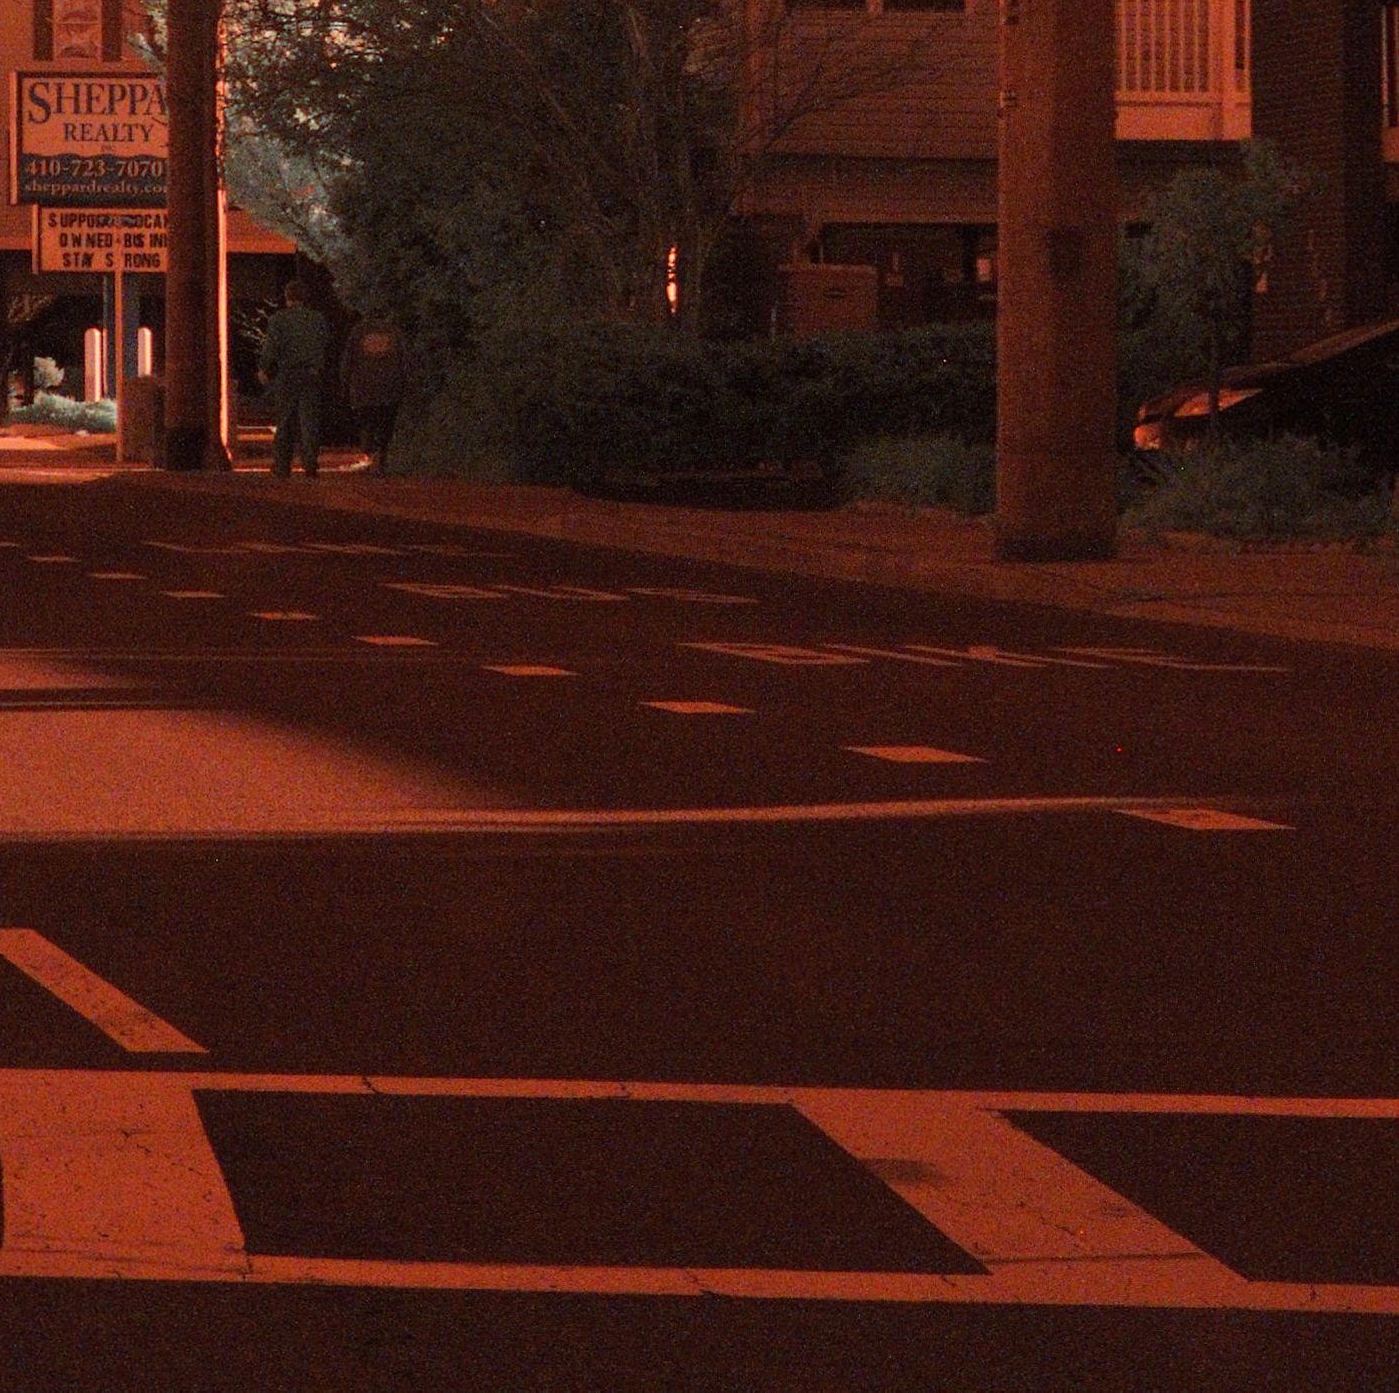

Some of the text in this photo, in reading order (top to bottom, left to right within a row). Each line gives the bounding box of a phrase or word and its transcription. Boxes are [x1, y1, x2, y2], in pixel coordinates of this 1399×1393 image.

[27, 81, 169, 124] SHEPPA
[64, 123, 154, 142] REALTY
[25, 160, 163, 177] 410-723-7070
[63, 252, 95, 267] STAY
